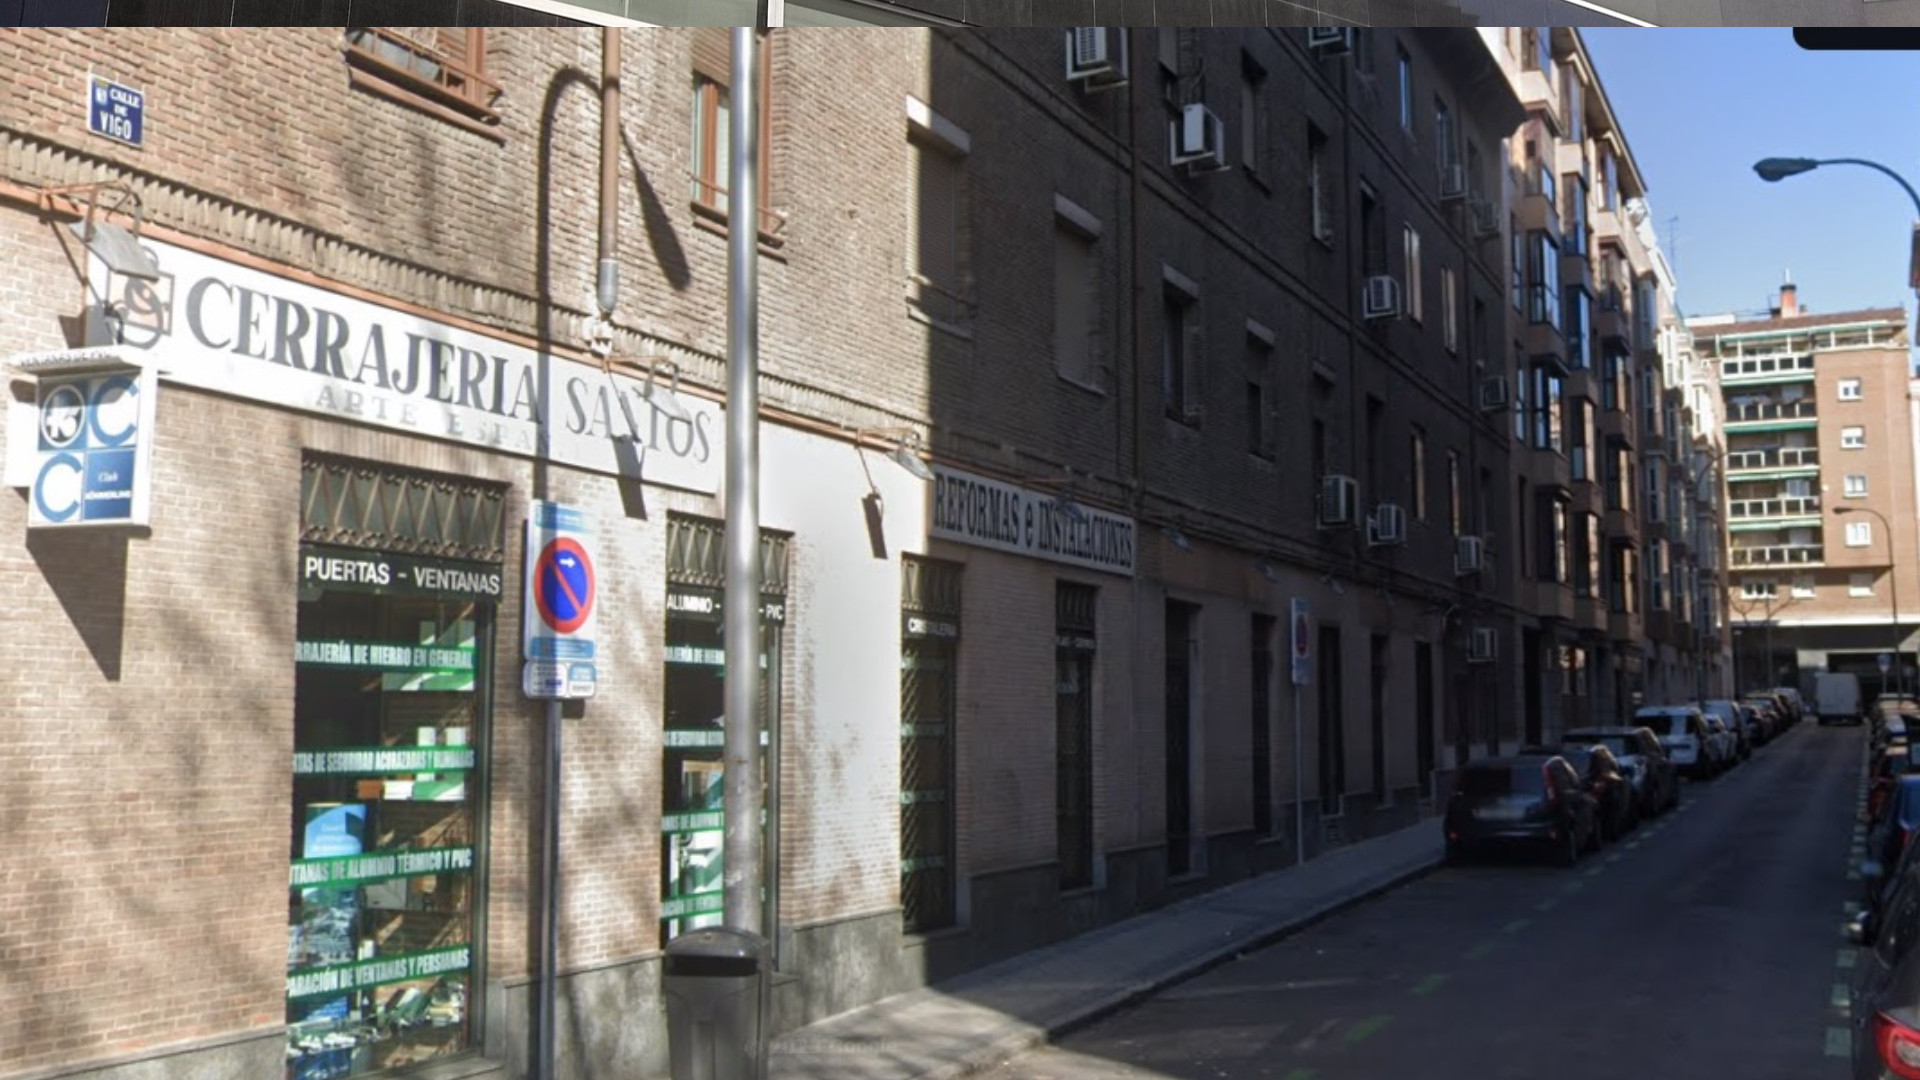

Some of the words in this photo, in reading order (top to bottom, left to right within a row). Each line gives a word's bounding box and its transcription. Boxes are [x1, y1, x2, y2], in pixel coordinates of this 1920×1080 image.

[109, 88, 140, 108] CALLE
[114, 104, 128, 117] DE
[100, 111, 132, 139] VIGO
[186, 277, 542, 424] CERRAJERIA
[566, 377, 711, 463] SANTOS
[316, 385, 417, 426] ARTE
[933, 472, 1019, 546] REFORMAS
[1025, 503, 1033, 547] e
[1039, 500, 1133, 569] INSTALACIONES
[305, 557, 390, 584] PUERTAS
[414, 567, 500, 594] VENTANAS
[353, 645, 368, 664] DE
[370, 645, 411, 667] HIERRO
[413, 649, 427, 667] EN
[429, 650, 473, 669] GENERAL
[451, 848, 472, 868] PVC
[355, 958, 407, 986] VENTANAS
